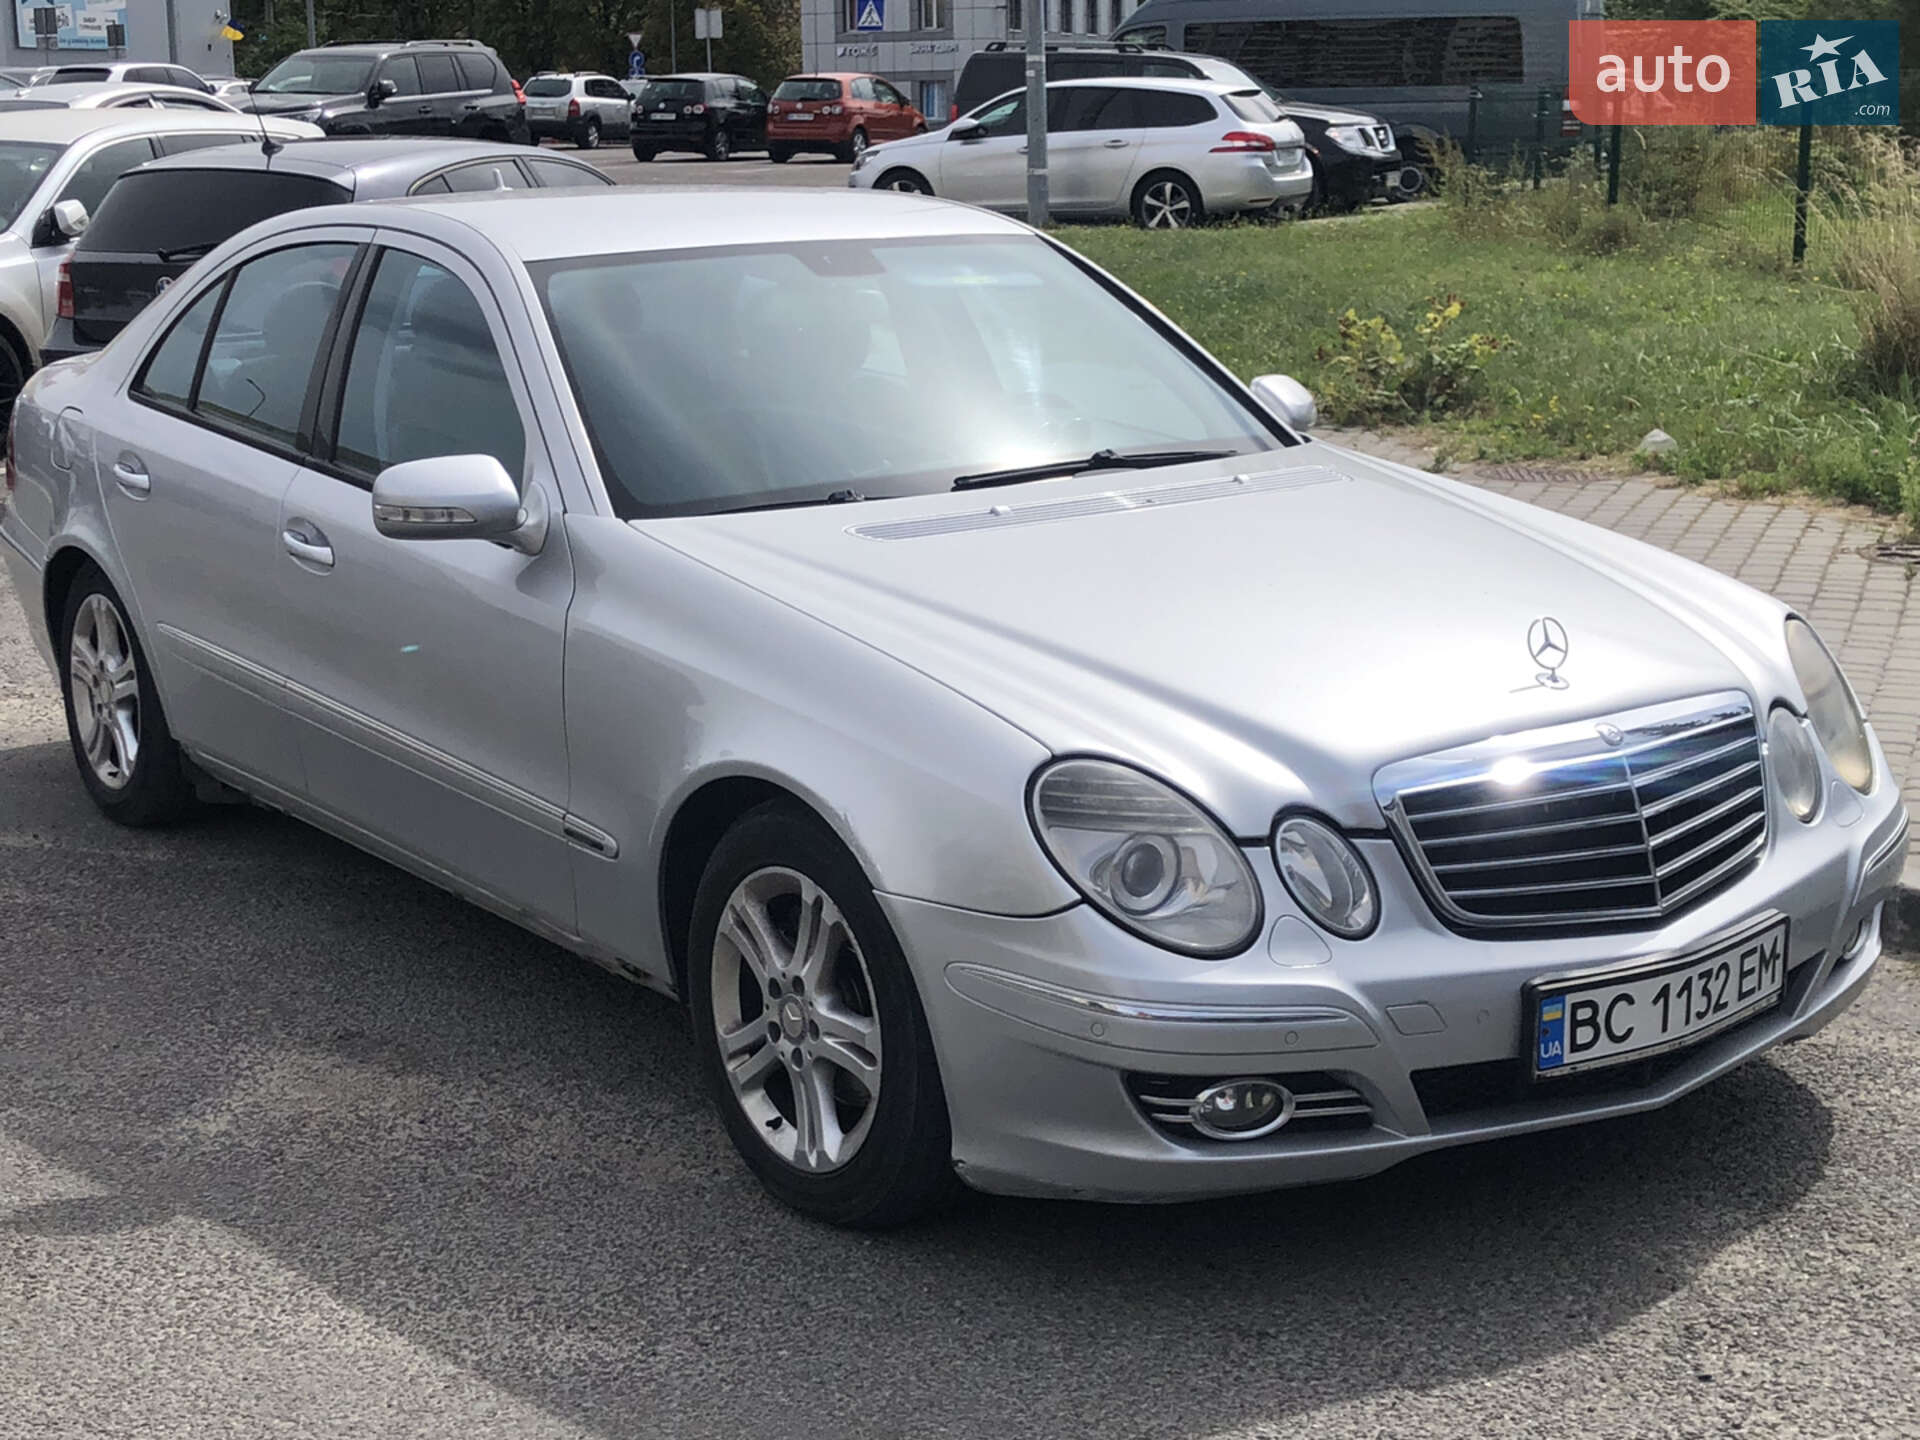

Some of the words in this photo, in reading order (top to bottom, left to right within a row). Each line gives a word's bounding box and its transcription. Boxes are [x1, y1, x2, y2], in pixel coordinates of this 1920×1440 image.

[1570, 993, 1635, 1053] BC
[1652, 961, 1730, 1033] 1132
[1738, 936, 1780, 1001] EM
[1540, 1040, 1562, 1058] UA
